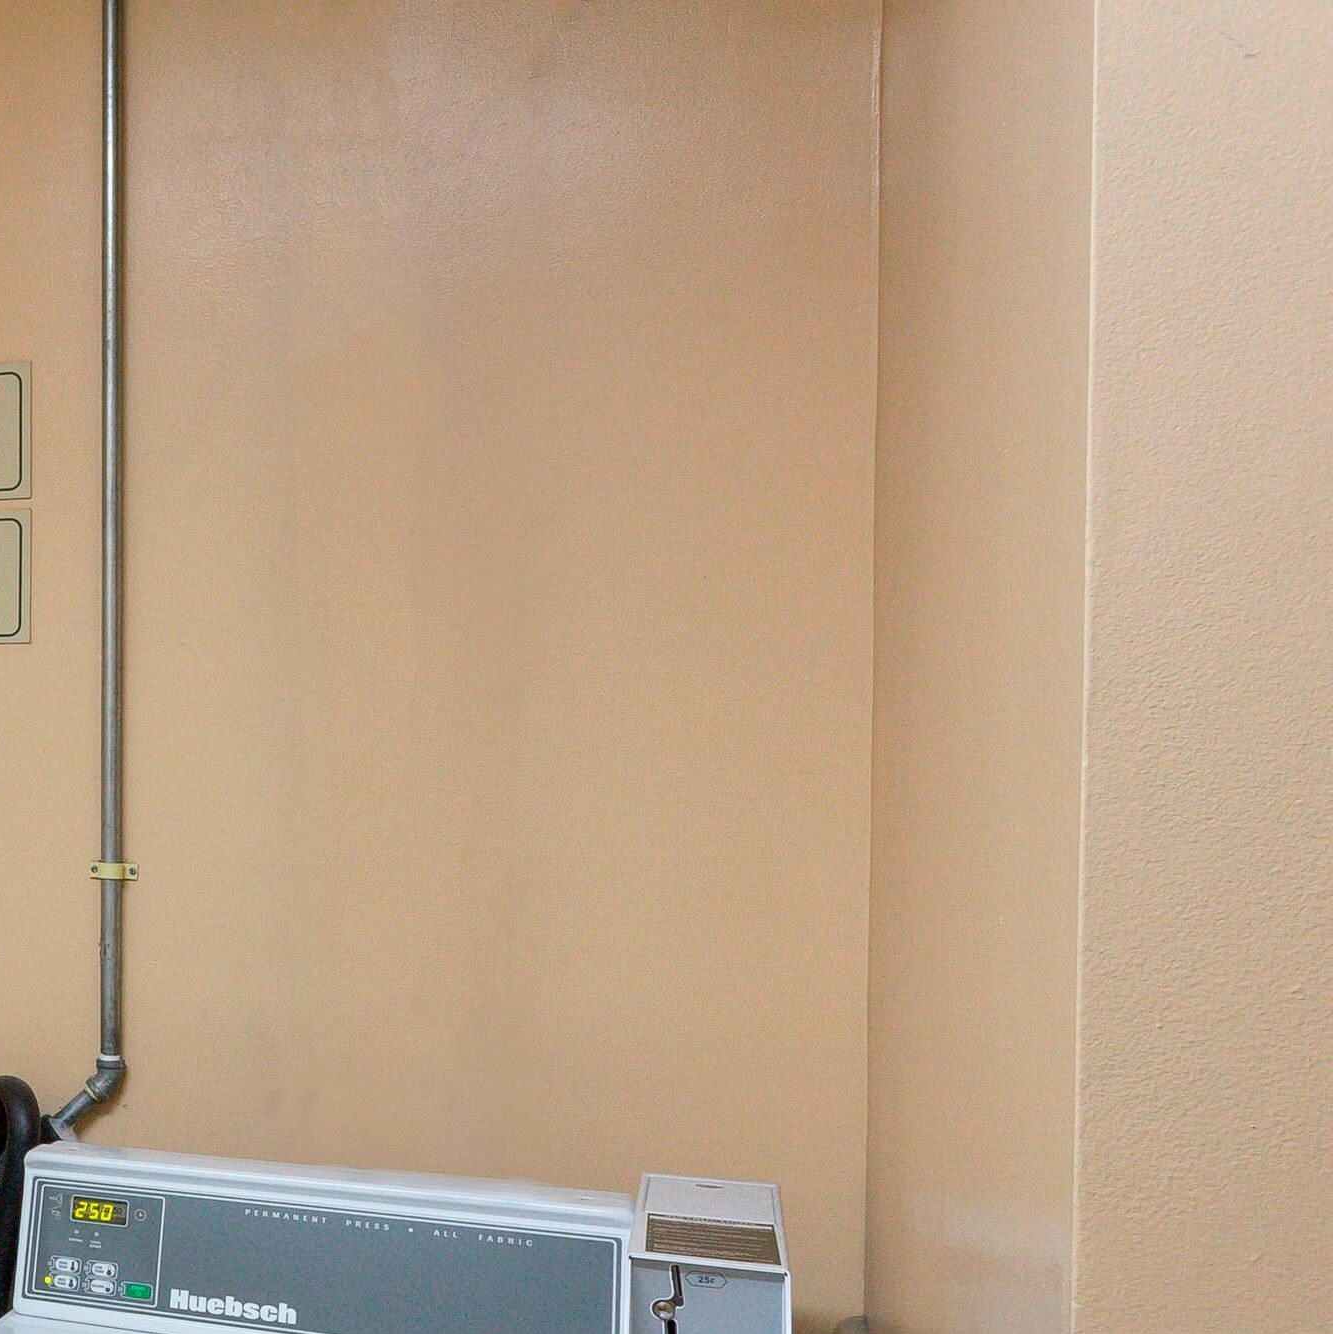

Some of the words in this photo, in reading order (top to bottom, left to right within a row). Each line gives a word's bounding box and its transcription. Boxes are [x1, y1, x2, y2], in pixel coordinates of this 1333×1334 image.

[74, 1201, 114, 1222] 250
[244, 1208, 328, 1224] PERMANENT
[345, 1218, 390, 1232] PRESS
[433, 1229, 459, 1239] ALL
[478, 1234, 534, 1247] FABRIC
[169, 1288, 297, 1325] Huebsch
